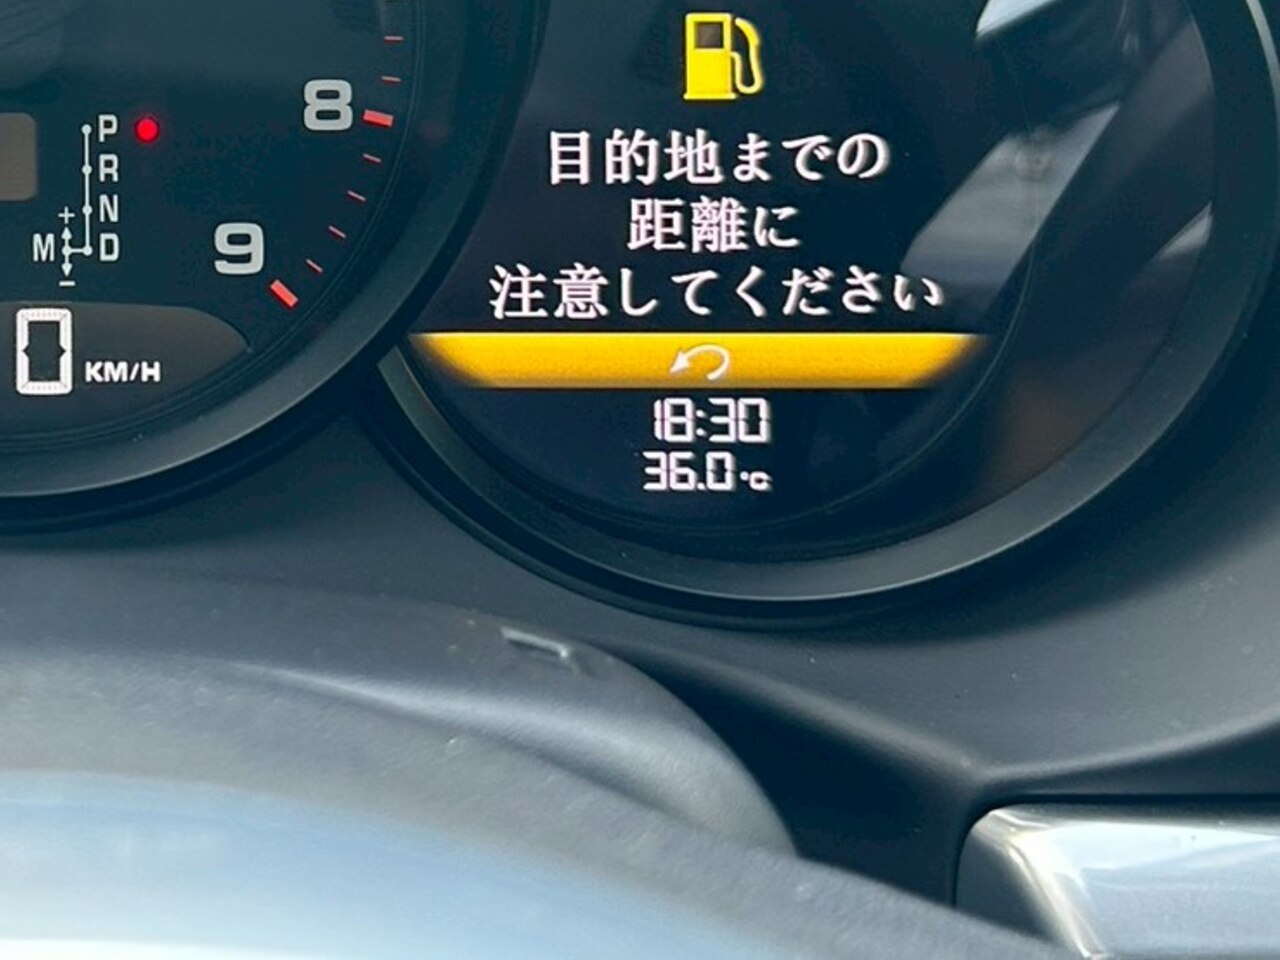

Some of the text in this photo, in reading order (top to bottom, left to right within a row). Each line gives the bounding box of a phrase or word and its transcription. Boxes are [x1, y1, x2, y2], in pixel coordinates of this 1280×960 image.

[99, 115, 117, 142] P
[304, 80, 352, 130] 8
[99, 153, 119, 182] R
[551, 128, 888, 185] 目的地までの
[100, 195, 118, 222] N
[628, 195, 798, 253] 距離に
[34, 234, 54, 261] M
[100, 233, 119, 261] D
[215, 223, 264, 274] 9
[490, 263, 942, 319] 注意してください
[17, 308, 160, 394] 0 KM/H
[654, 398, 769, 442] 18:30
